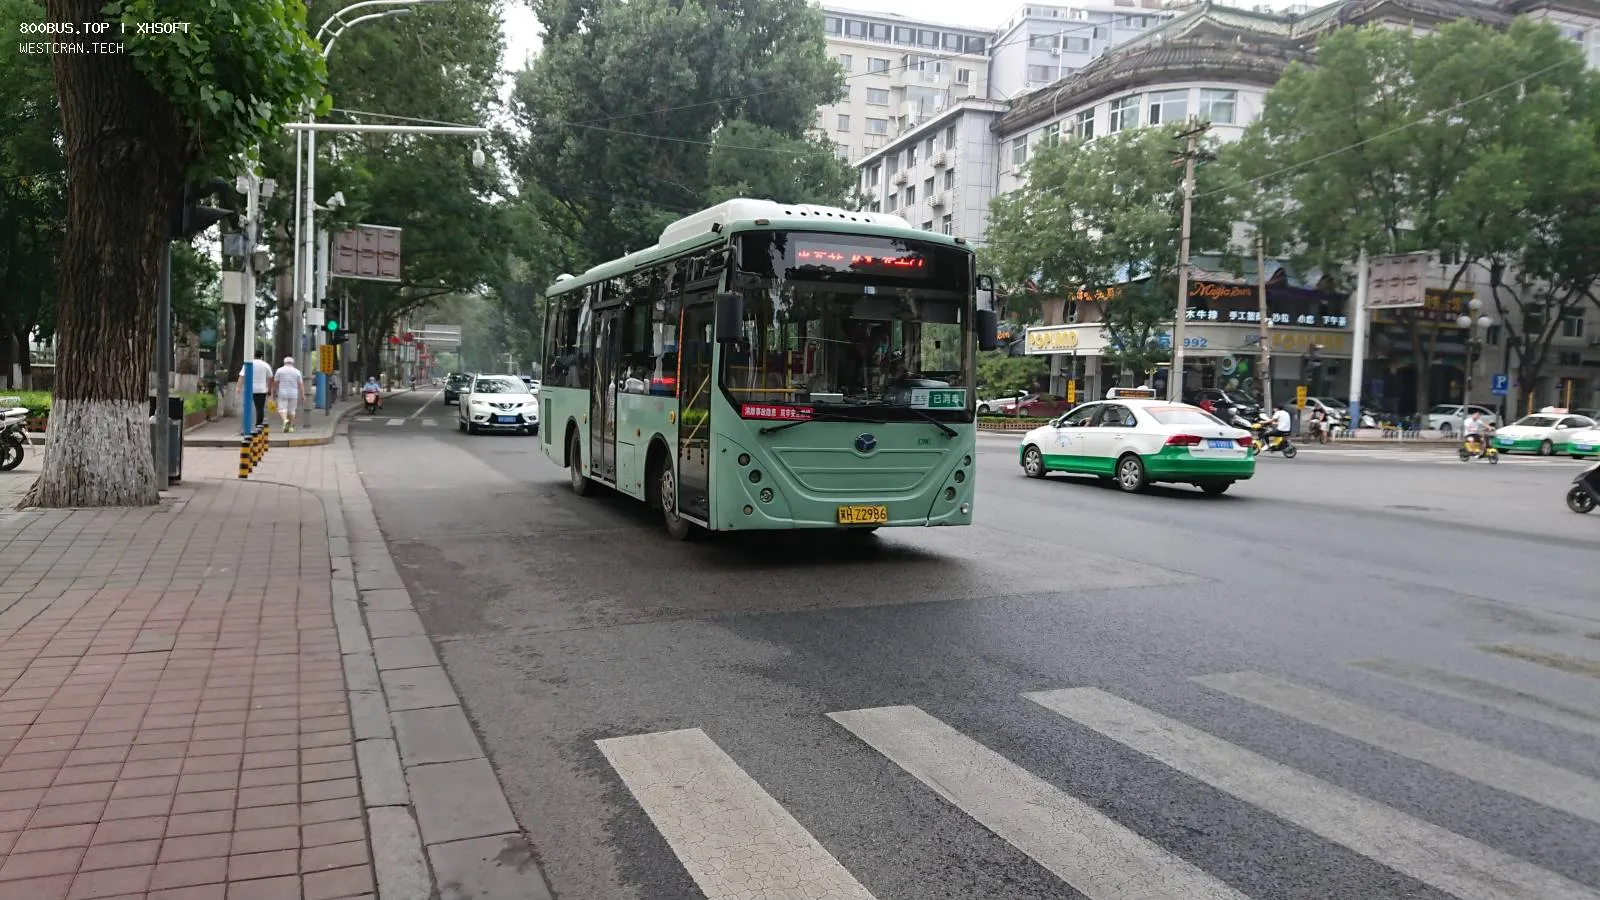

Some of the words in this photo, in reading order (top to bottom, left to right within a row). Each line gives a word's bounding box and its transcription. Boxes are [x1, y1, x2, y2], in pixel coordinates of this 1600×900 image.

[1189, 282, 1230, 300] Magic
[1175, 309, 1218, 320] 木牛排
[1322, 315, 1347, 327] 下午茶
[1183, 337, 1208, 348] 992
[1496, 375, 1507, 389] P
